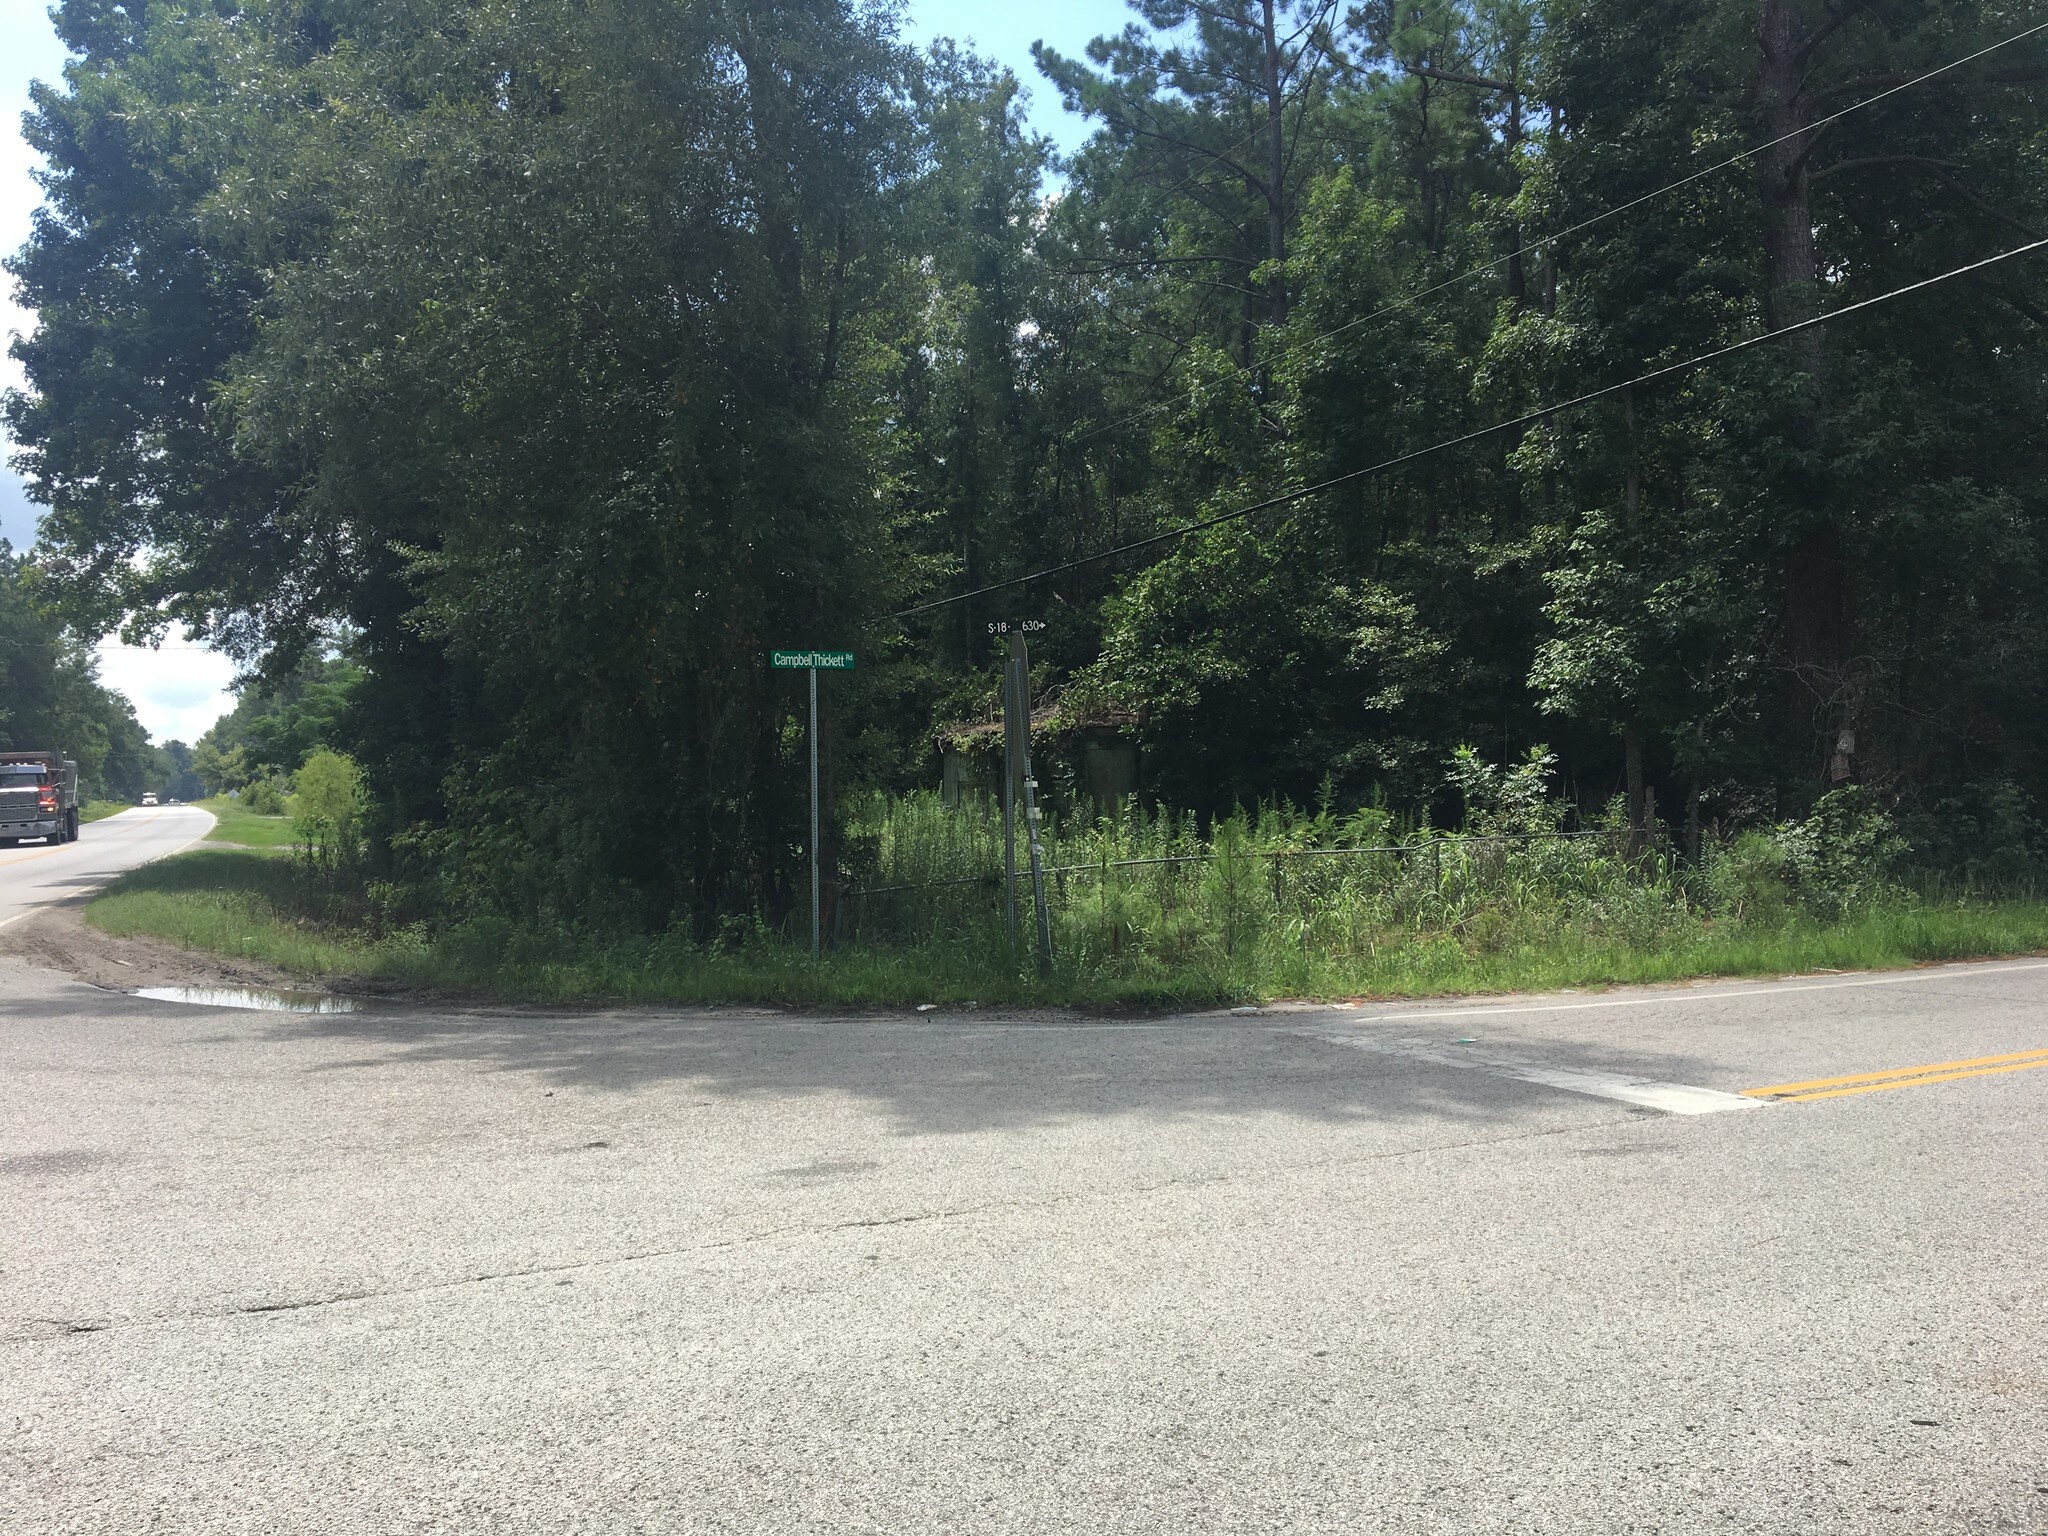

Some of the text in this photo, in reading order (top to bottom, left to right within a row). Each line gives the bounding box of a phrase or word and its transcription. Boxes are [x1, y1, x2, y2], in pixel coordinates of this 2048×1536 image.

[1022, 620, 1039, 631] 630
[774, 652, 812, 668] Campbell
[813, 653, 844, 667] Thickett
